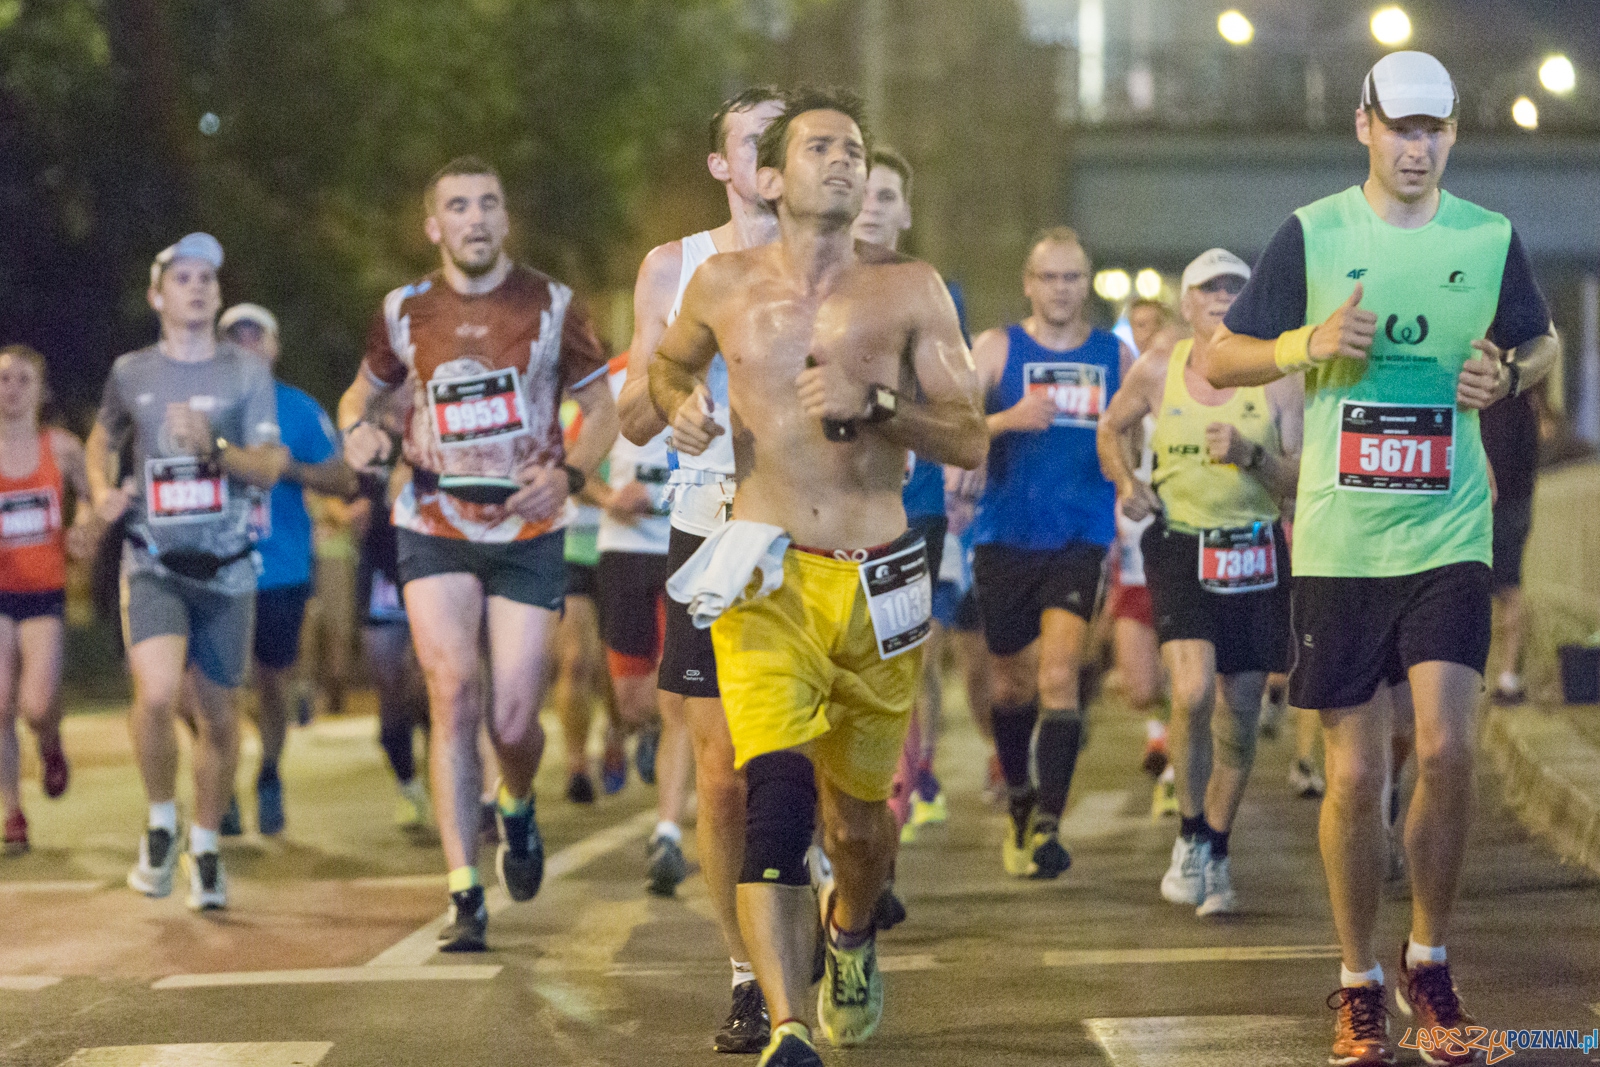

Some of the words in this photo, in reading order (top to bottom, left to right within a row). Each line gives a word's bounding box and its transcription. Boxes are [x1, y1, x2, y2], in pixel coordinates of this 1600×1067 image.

[1346, 268, 1368, 280] 4F
[444, 397, 509, 431] 9953
[1360, 438, 1431, 473] 5671
[1214, 549, 1266, 578] 7384
